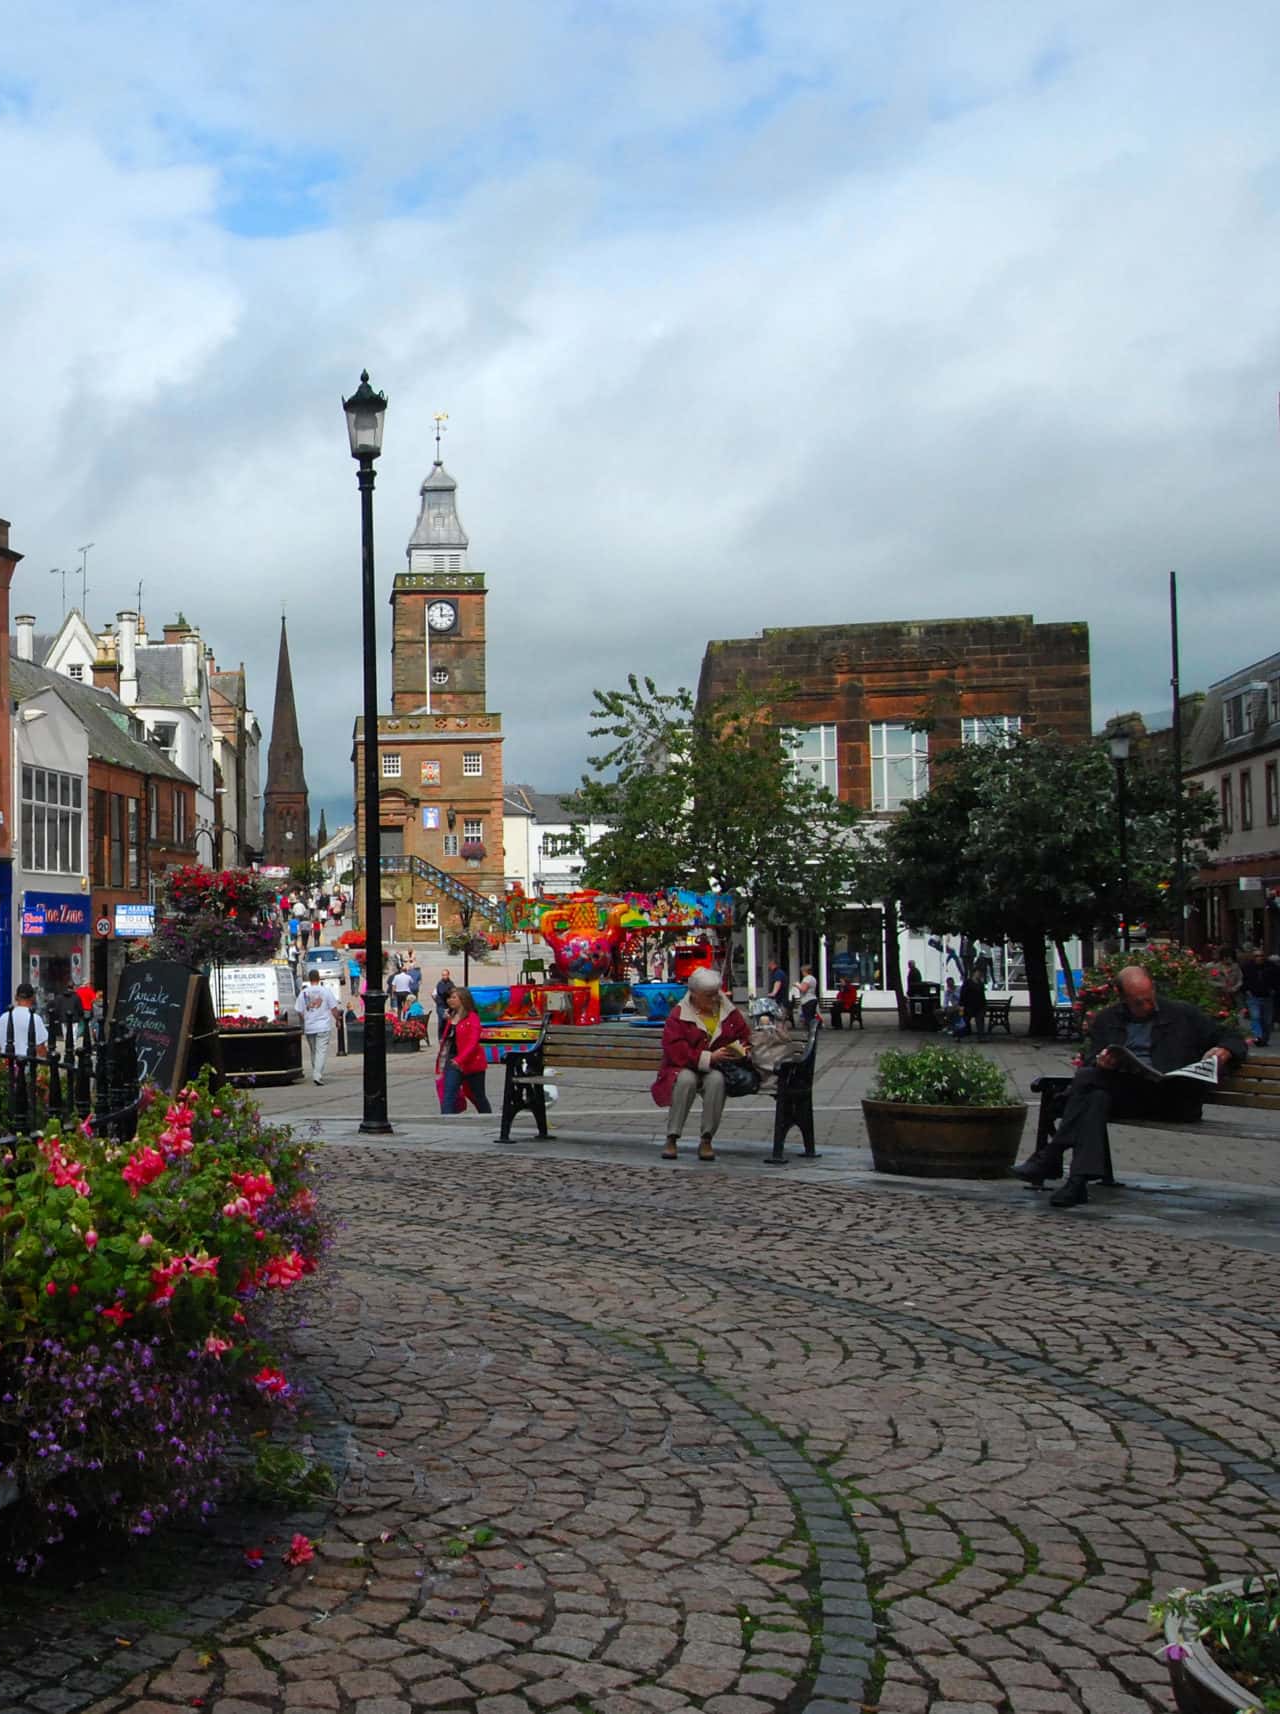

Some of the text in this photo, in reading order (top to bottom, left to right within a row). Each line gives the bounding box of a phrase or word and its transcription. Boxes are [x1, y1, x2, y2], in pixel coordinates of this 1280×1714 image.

[23, 912, 43, 923] Shoe
[60, 903, 84, 923] Zone
[97, 921, 110, 932] 20
[128, 982, 169, 1004] Pancake
